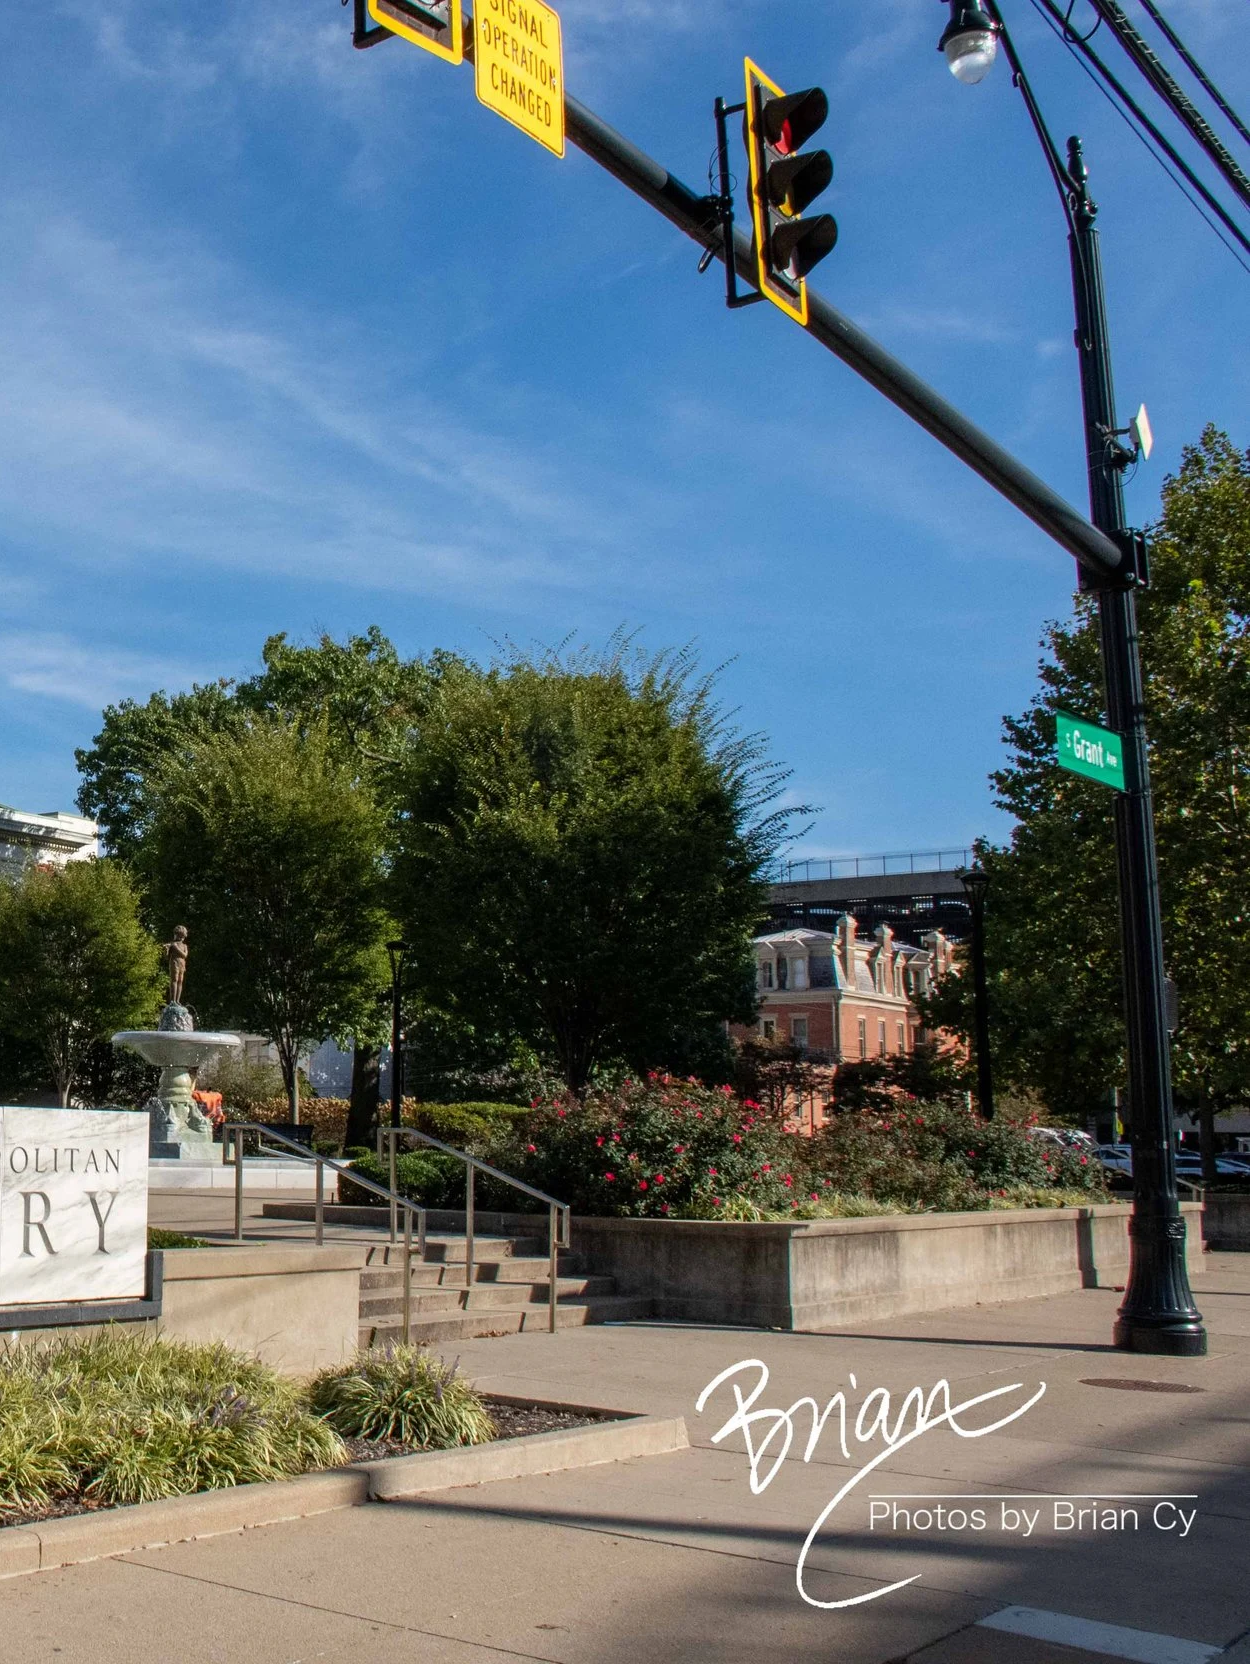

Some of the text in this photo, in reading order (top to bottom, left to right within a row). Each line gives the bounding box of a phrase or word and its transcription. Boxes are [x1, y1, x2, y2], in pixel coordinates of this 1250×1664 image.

[483, 18, 557, 94] OPERATION
[491, 62, 552, 127] CHANGED
[1065, 733, 1072, 748] S
[1073, 730, 1105, 768] Grant
